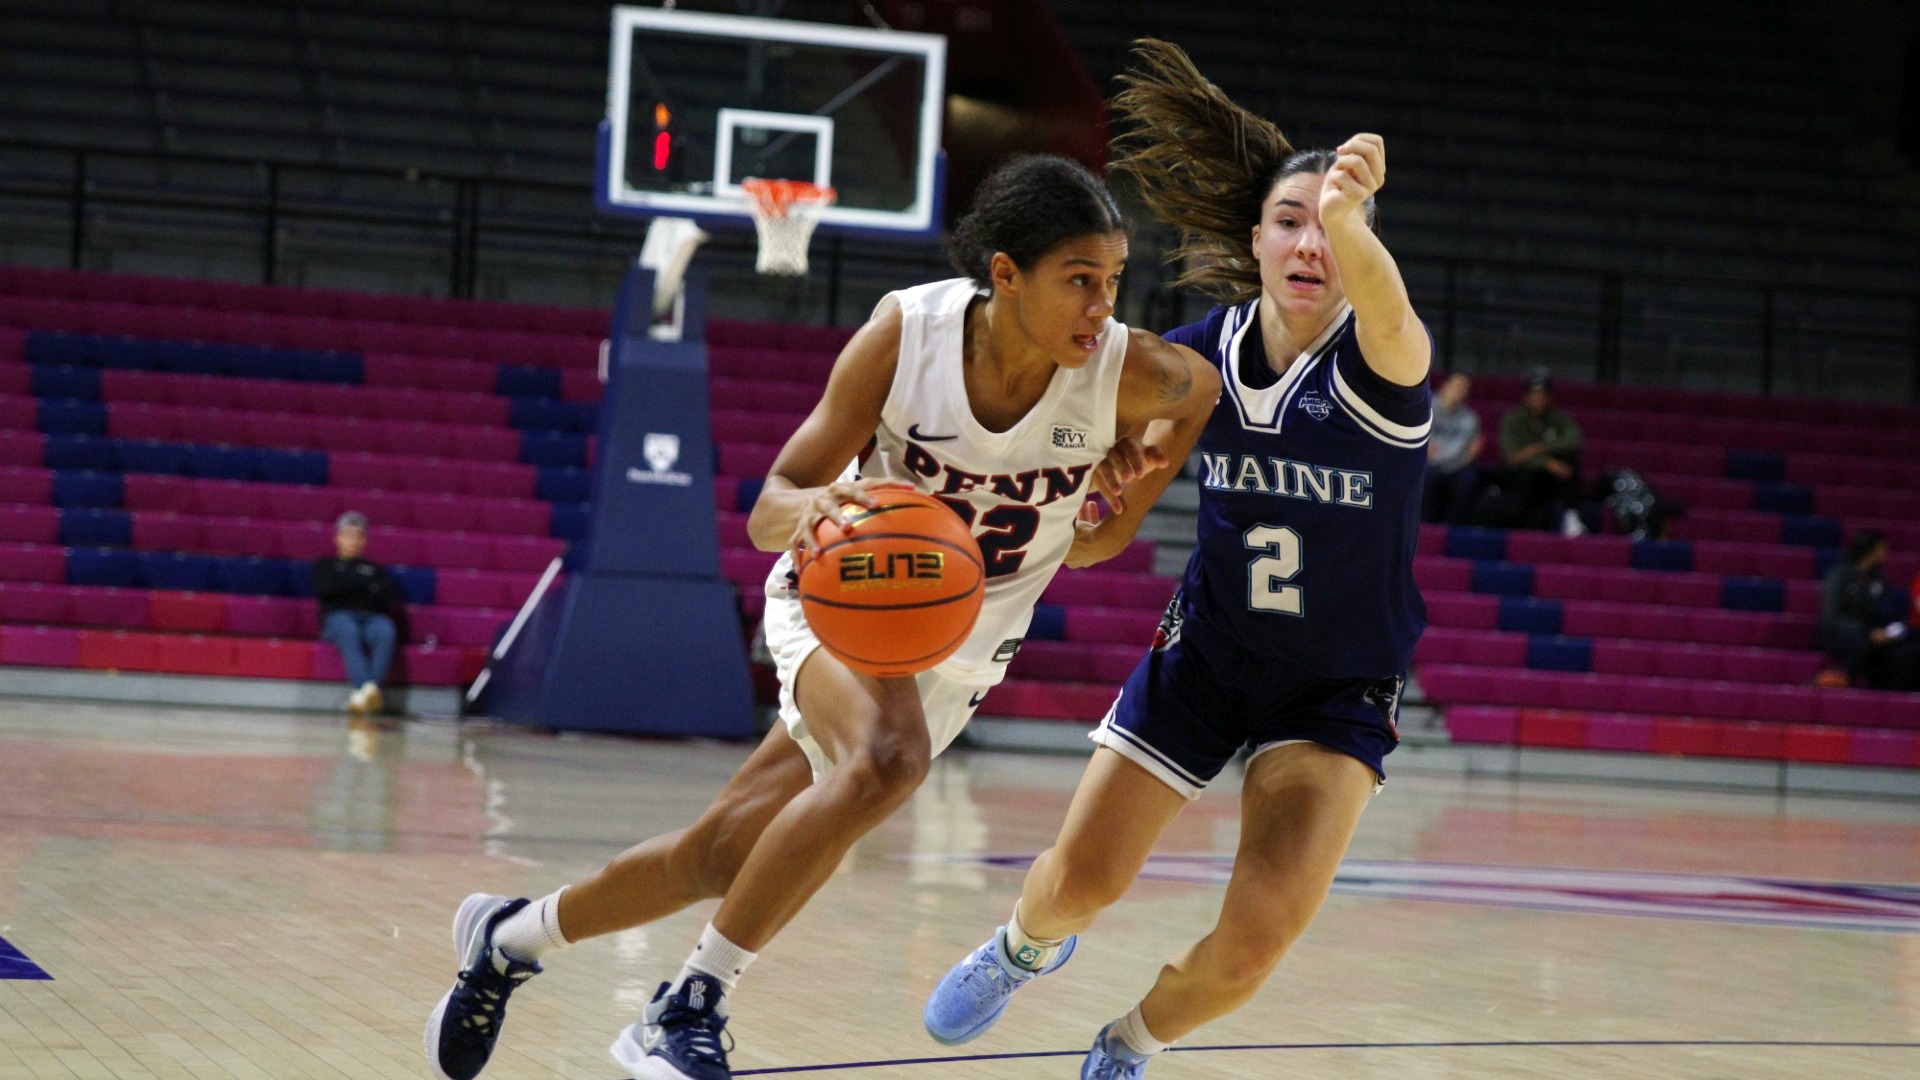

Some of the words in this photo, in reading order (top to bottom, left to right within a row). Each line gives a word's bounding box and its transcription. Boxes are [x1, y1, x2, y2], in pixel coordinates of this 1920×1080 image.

[1309, 405, 1327, 413] EAST
[1062, 432, 1087, 443] IVY
[903, 440, 1093, 507] PENN
[1202, 452, 1373, 509] MAINE
[840, 552, 944, 582] ELITE
[1242, 522, 1304, 618] 2
